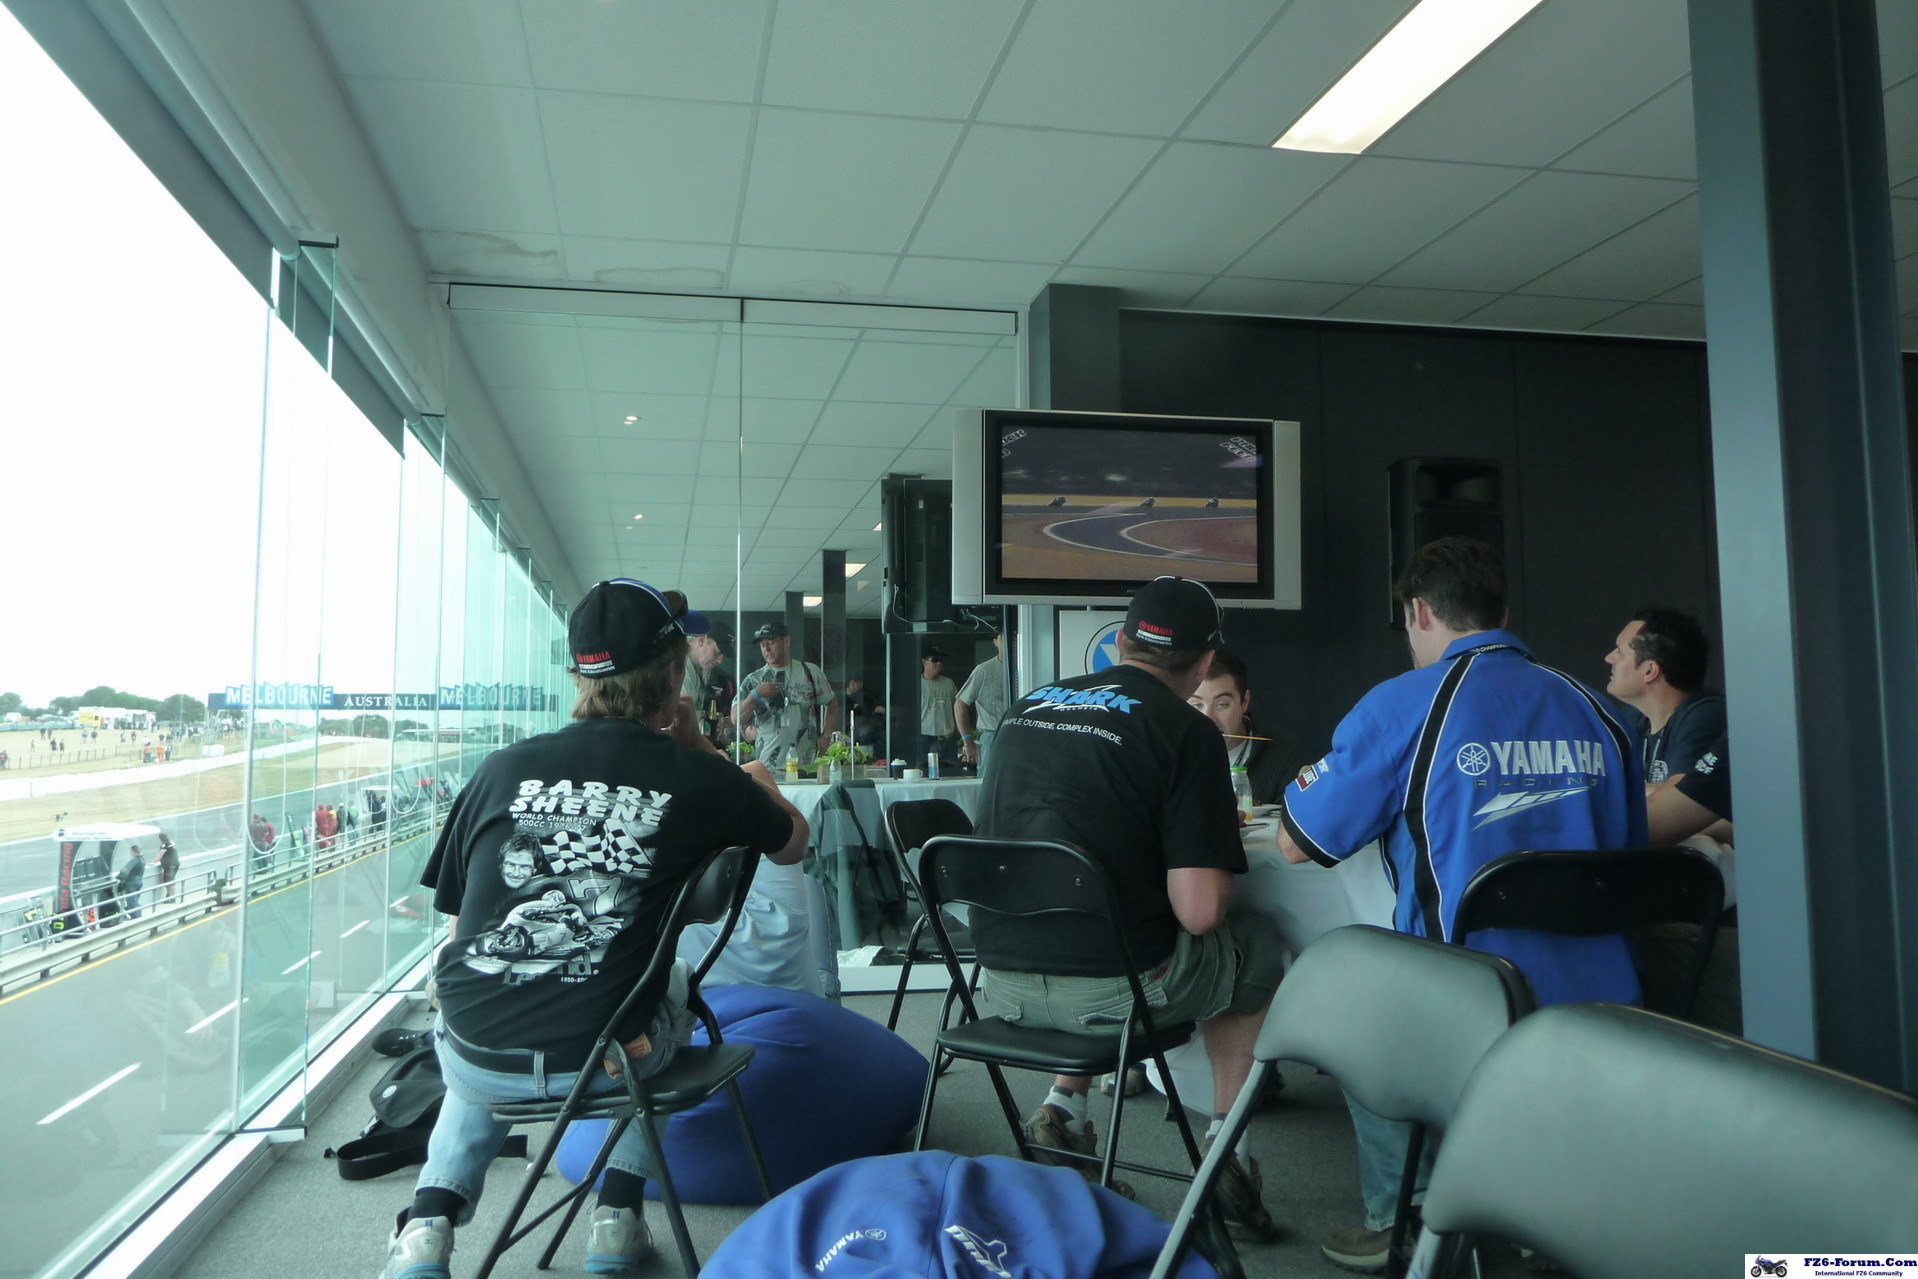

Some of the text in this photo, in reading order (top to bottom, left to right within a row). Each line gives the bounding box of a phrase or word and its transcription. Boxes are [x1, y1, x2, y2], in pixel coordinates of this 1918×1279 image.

[583, 651, 611, 662] YAMAHA
[227, 683, 543, 707] MELBOURNE AUSTRALIA MELBOURNE
[1025, 686, 1142, 714] SHARK
[1056, 723, 1093, 734] COMPLEX
[1093, 727, 1122, 746] INSIDE.
[1490, 740, 1606, 777] YAMAHA
[518, 779, 672, 808] BARRY
[509, 796, 663, 827] SHEENE
[512, 812, 597, 827] WORLD CHAMPION
[518, 819, 545, 828] 500CC
[567, 876, 624, 916] 7
[815, 1230, 865, 1272] YAMAHA
